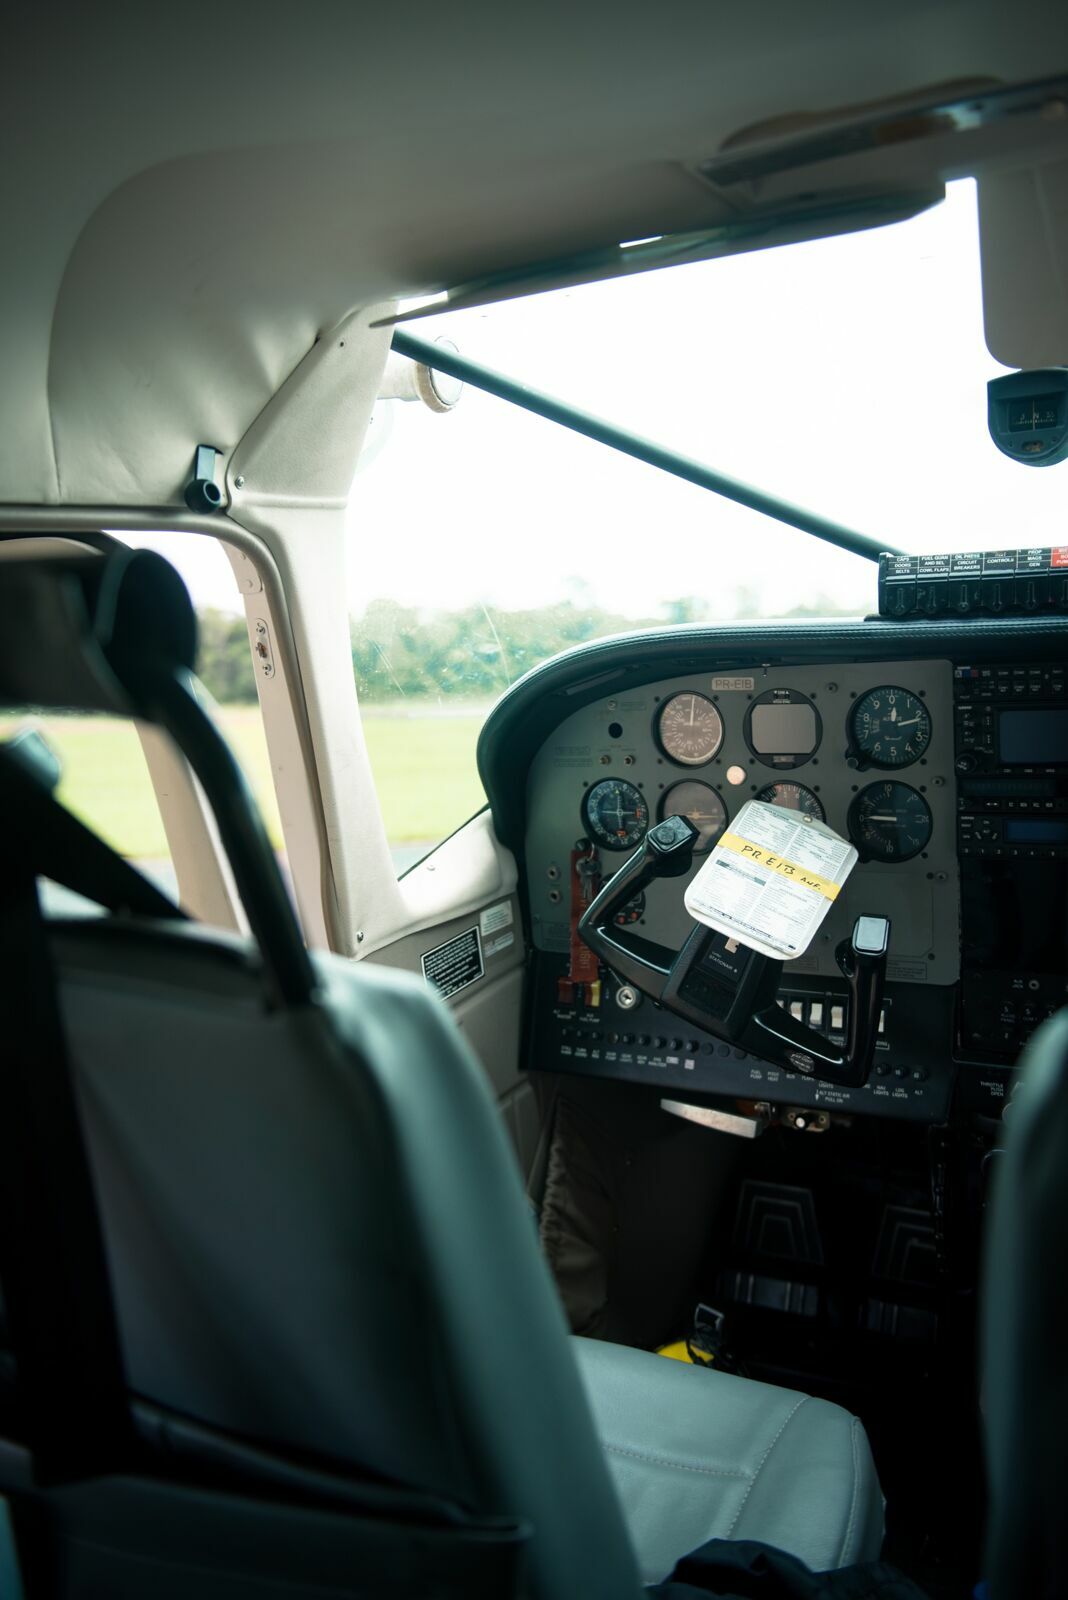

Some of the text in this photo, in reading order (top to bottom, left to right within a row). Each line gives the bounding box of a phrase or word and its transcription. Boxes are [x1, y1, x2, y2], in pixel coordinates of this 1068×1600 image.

[715, 680, 752, 688] PR-EIB
[889, 695, 895, 704] 0
[873, 700, 880, 709] 9
[863, 713, 869, 721] 8
[915, 710, 921, 719] 2
[863, 730, 869, 739] 7
[916, 732, 923, 741] 3
[874, 743, 881, 751] 6
[890, 747, 897, 756] 5
[905, 743, 911, 751] 4
[741, 845, 762, 859] PR
